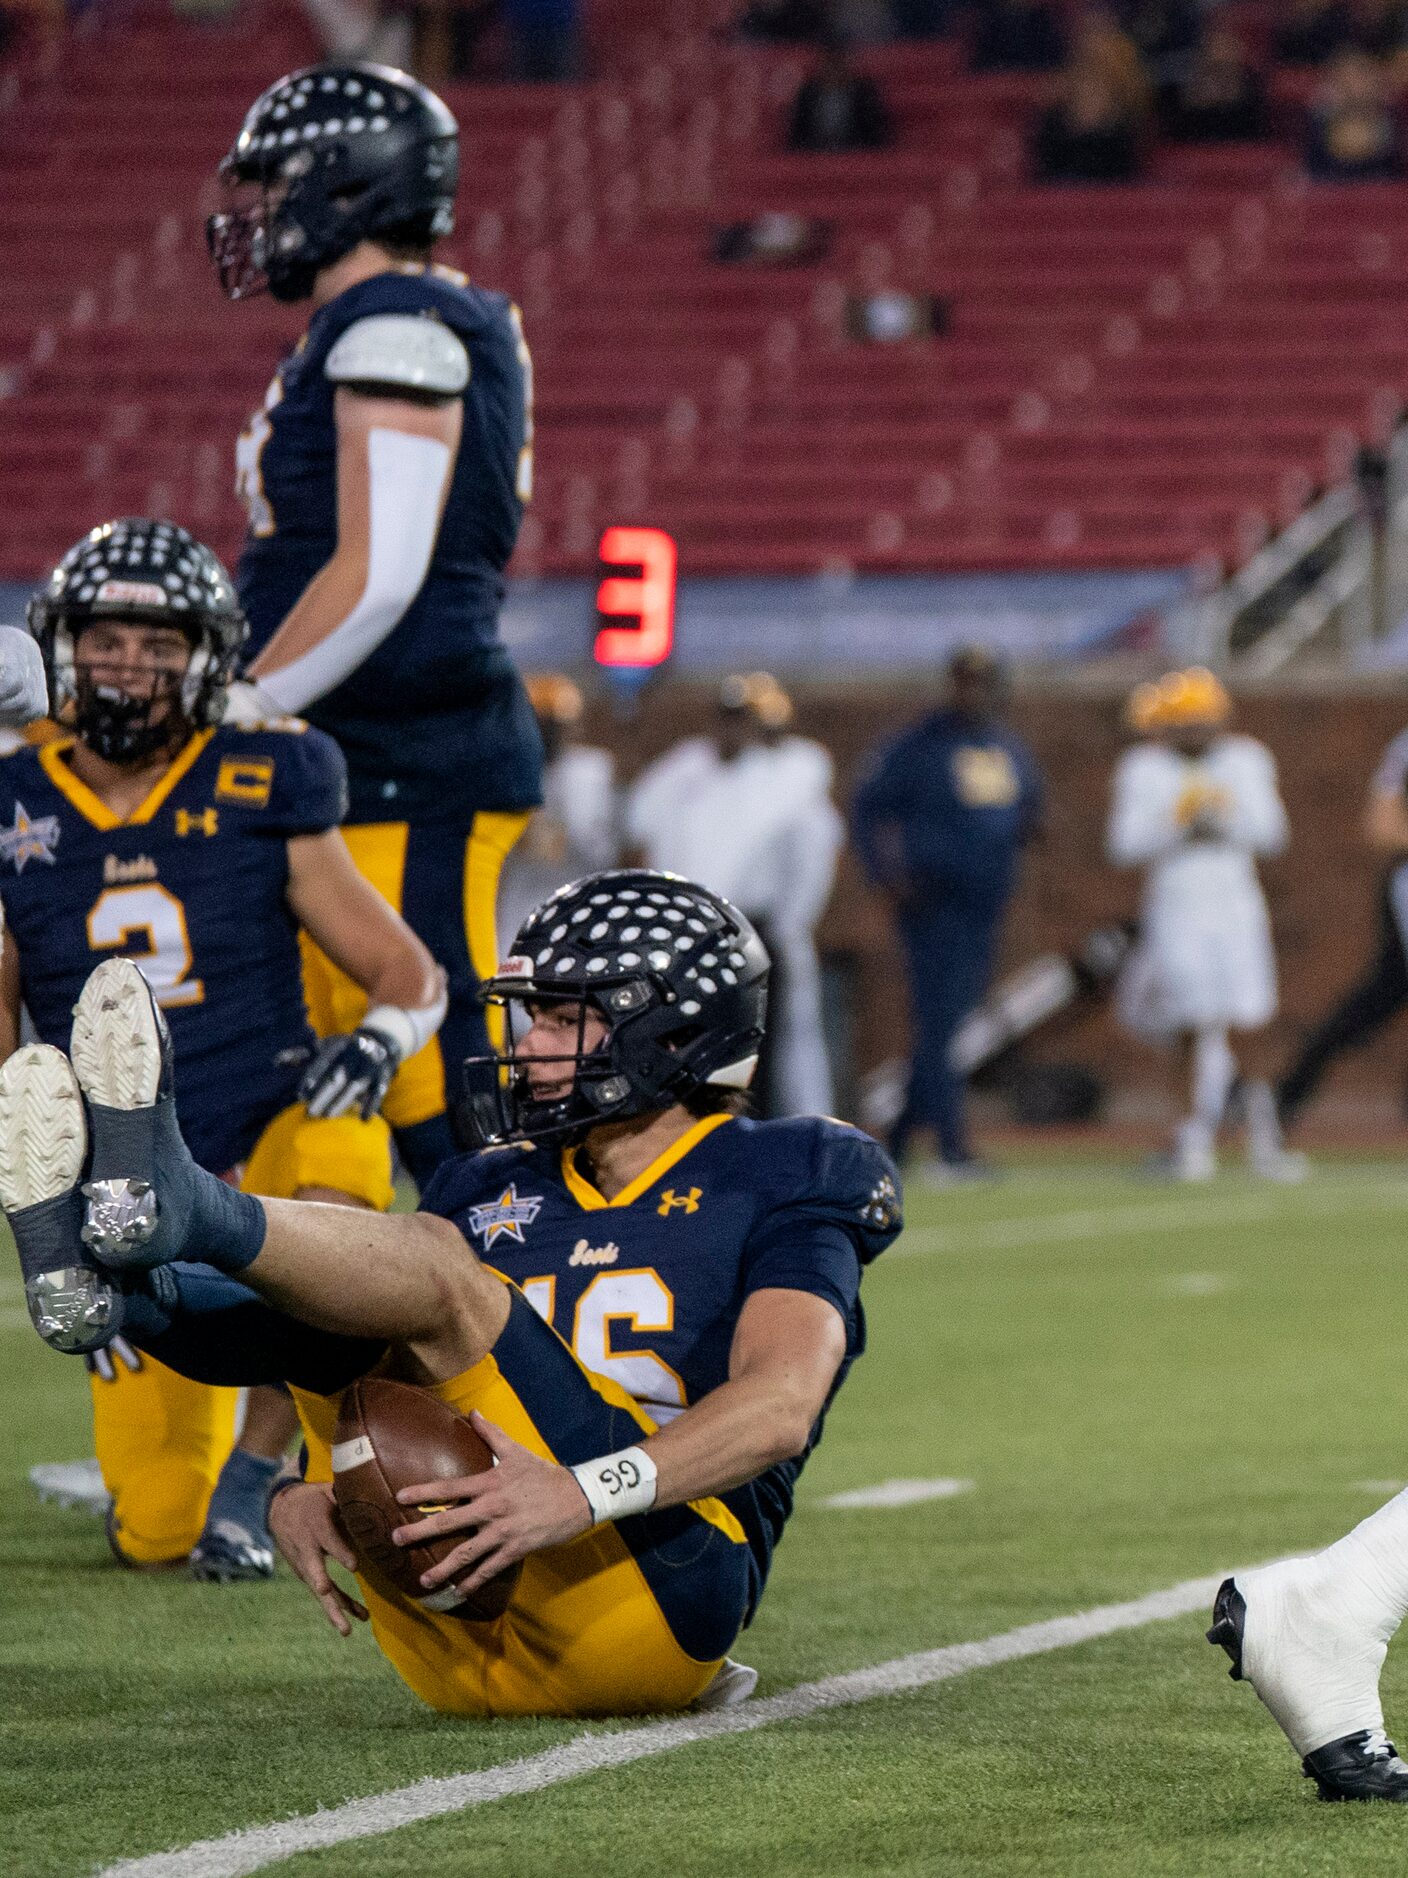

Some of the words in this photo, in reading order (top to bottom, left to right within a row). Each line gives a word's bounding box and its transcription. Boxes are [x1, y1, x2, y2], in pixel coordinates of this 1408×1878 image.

[594, 526, 678, 668] 3
[216, 761, 274, 800] C
[86, 882, 206, 1008] 2
